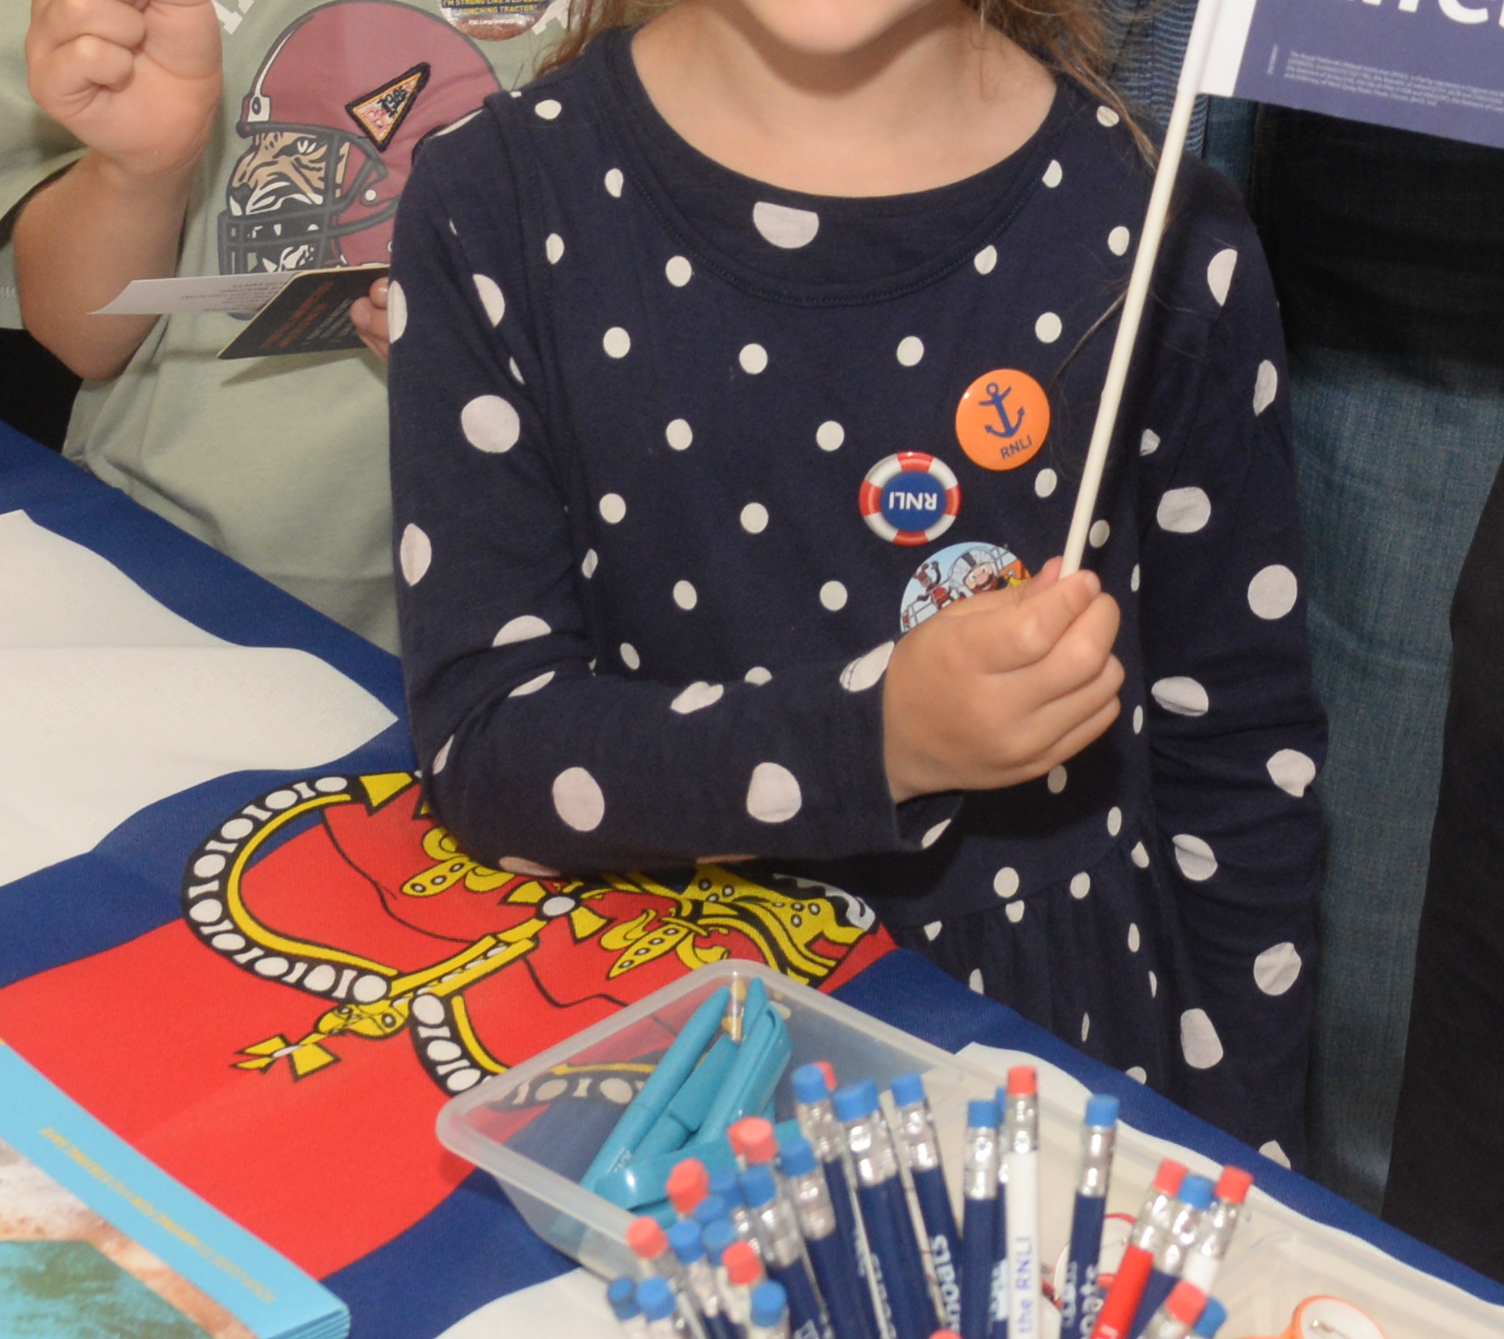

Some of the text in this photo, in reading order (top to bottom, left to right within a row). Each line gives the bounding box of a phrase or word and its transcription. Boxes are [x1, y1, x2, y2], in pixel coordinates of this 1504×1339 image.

[1000, 434, 1033, 460] RNLI
[888, 491, 938, 511] RNLI
[1016, 1236, 1035, 1336] the RNLI
